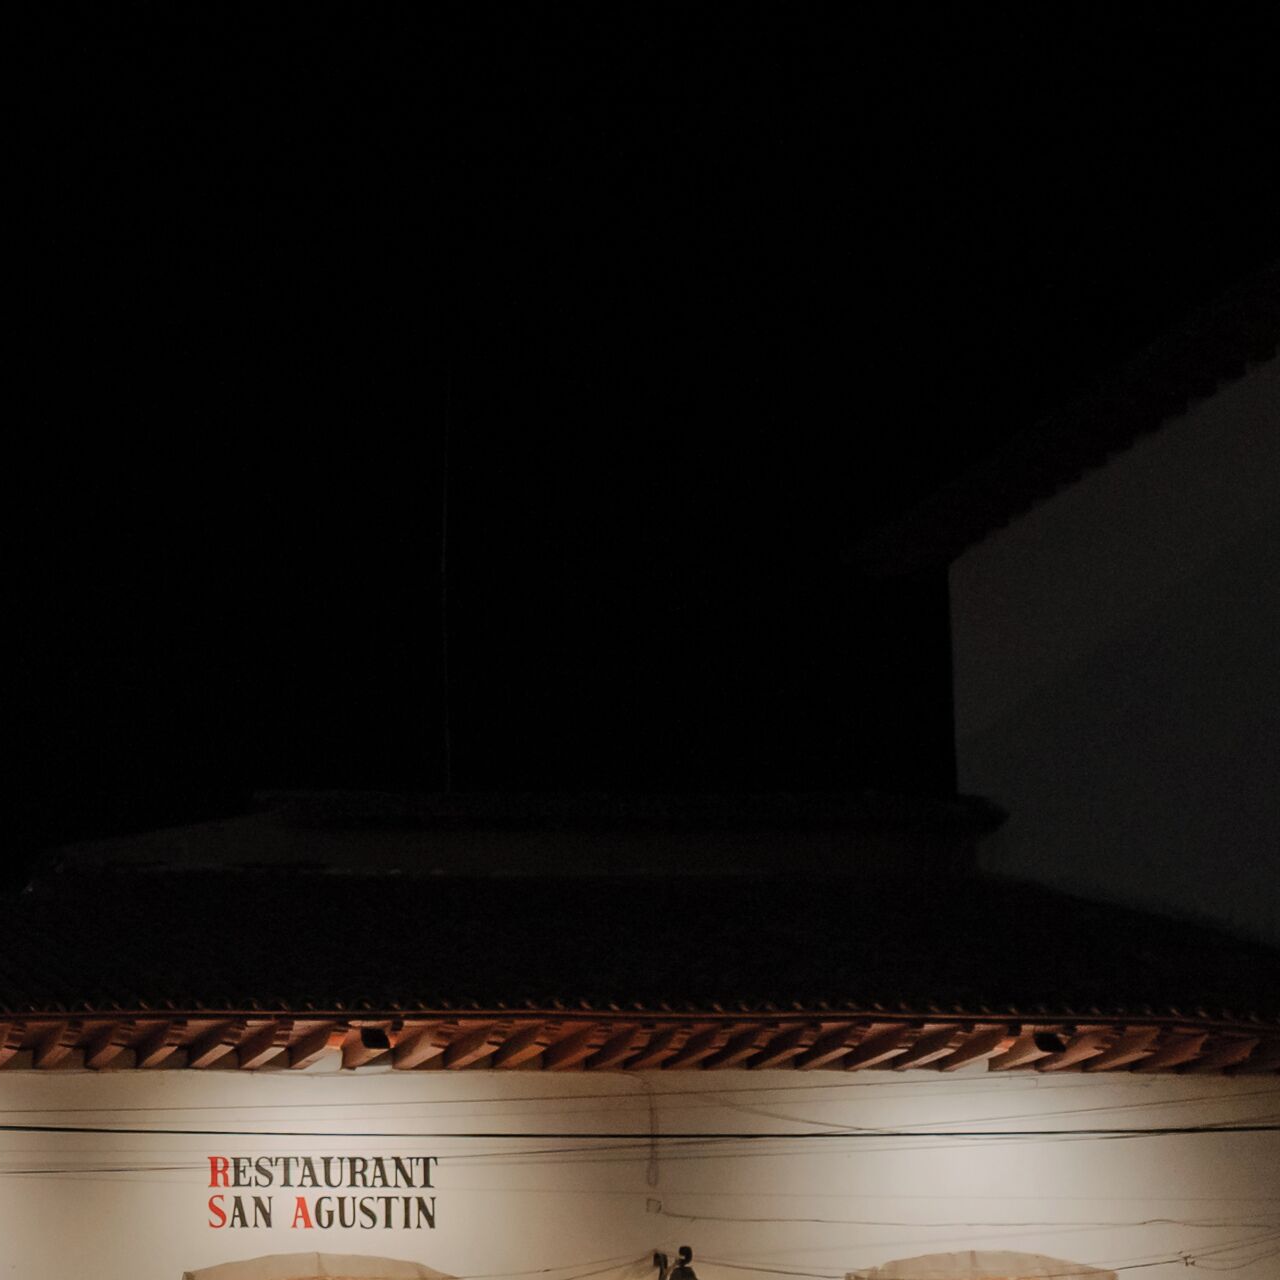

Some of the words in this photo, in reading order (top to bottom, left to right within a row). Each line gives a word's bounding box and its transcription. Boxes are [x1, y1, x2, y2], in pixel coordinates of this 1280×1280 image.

[207, 1156, 438, 1188] RESTAURANT
[208, 1194, 273, 1229] SAN
[292, 1196, 436, 1229] AGUSTIN
